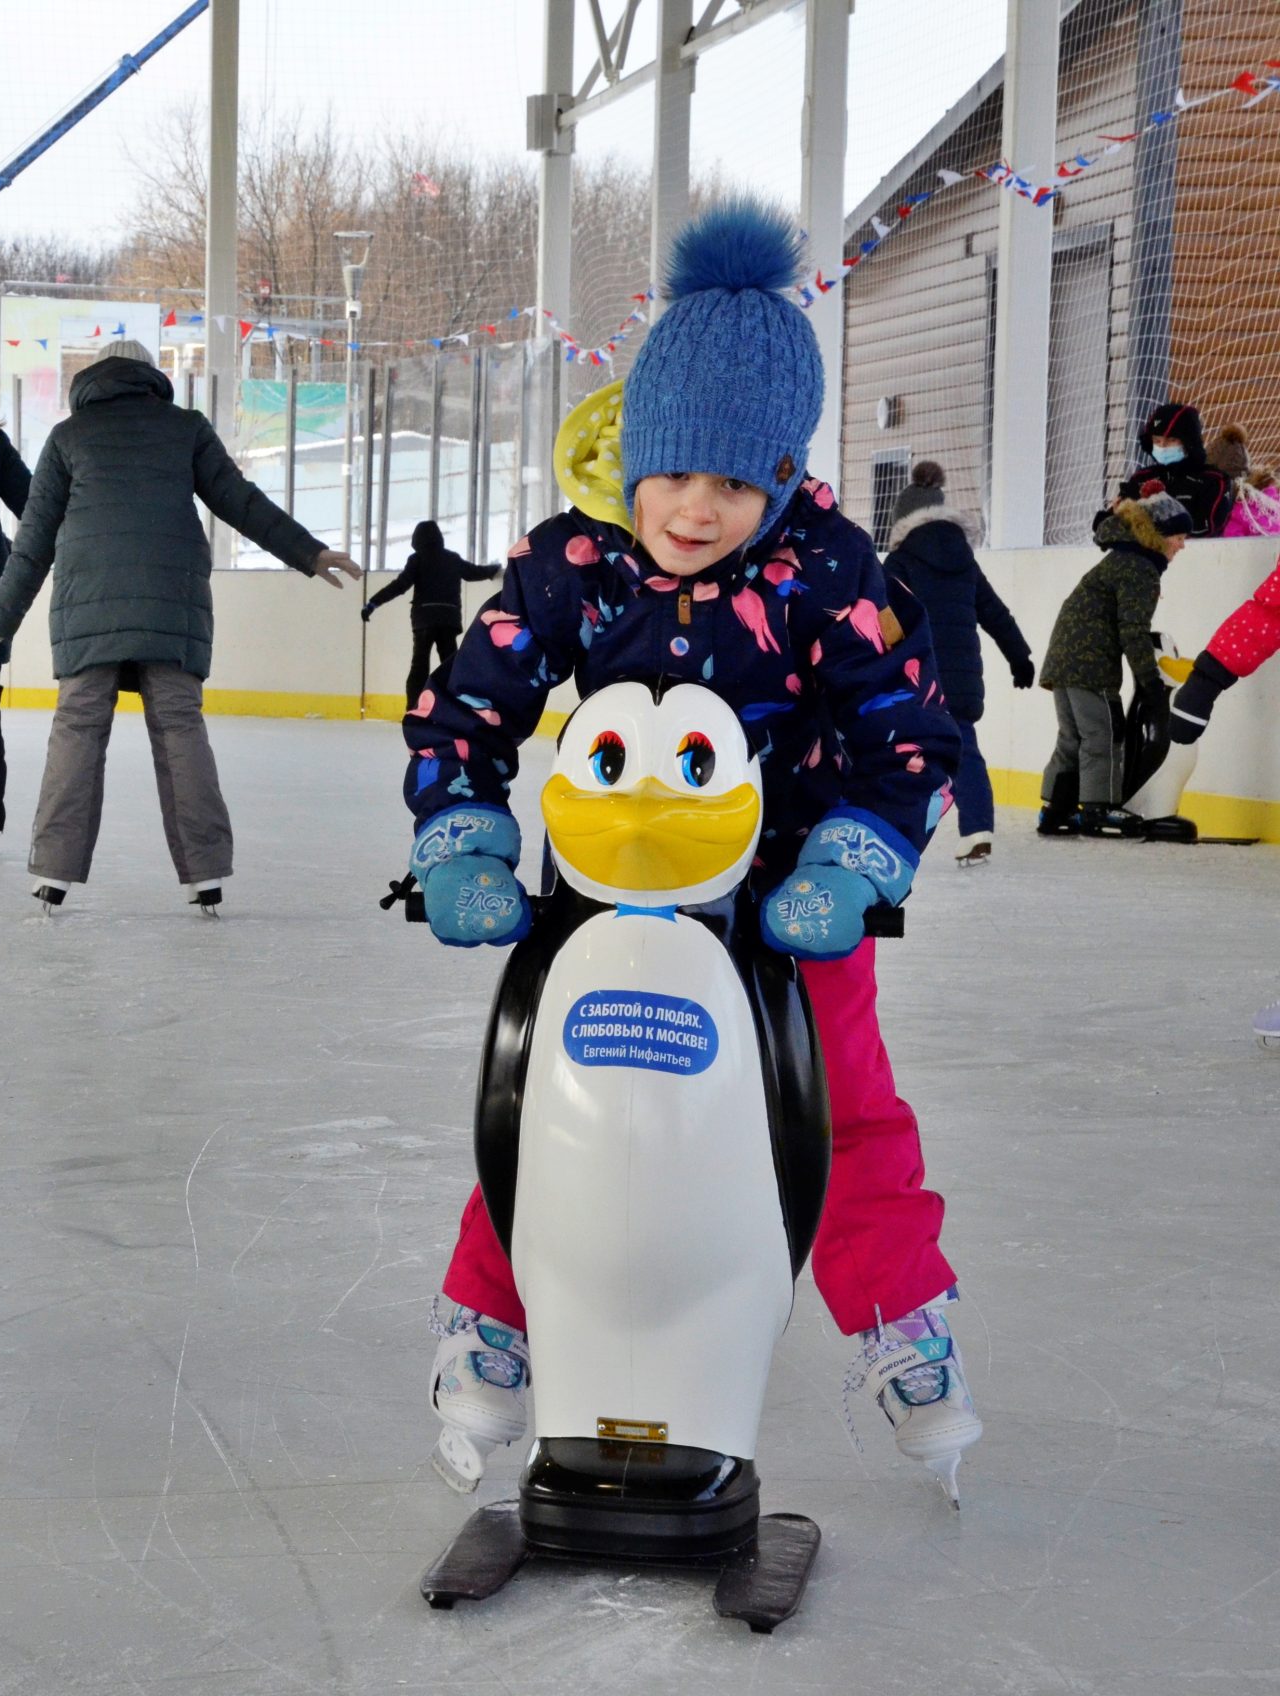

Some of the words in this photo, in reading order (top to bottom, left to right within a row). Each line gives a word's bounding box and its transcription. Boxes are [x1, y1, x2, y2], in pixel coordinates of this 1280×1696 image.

[820, 825, 859, 844] LOVE
[456, 887, 516, 916] LOVE
[778, 891, 833, 920] LOVE
[580, 1004, 587, 1017] С
[588, 1002, 641, 1017] ЗАБОТОЙ
[644, 1006, 653, 1019] О
[655, 1007, 703, 1029] ЛЮДЯХ.
[571, 1025, 579, 1038] С
[579, 1023, 643, 1038] ЛЮБОВЬЮ
[645, 1026, 654, 1040] К
[656, 1028, 708, 1050] МОСКВЕ!
[583, 1044, 626, 1058] Евгений
[629, 1046, 691, 1068] Нифантьев
[878, 1353, 917, 1376] NORDWAY
